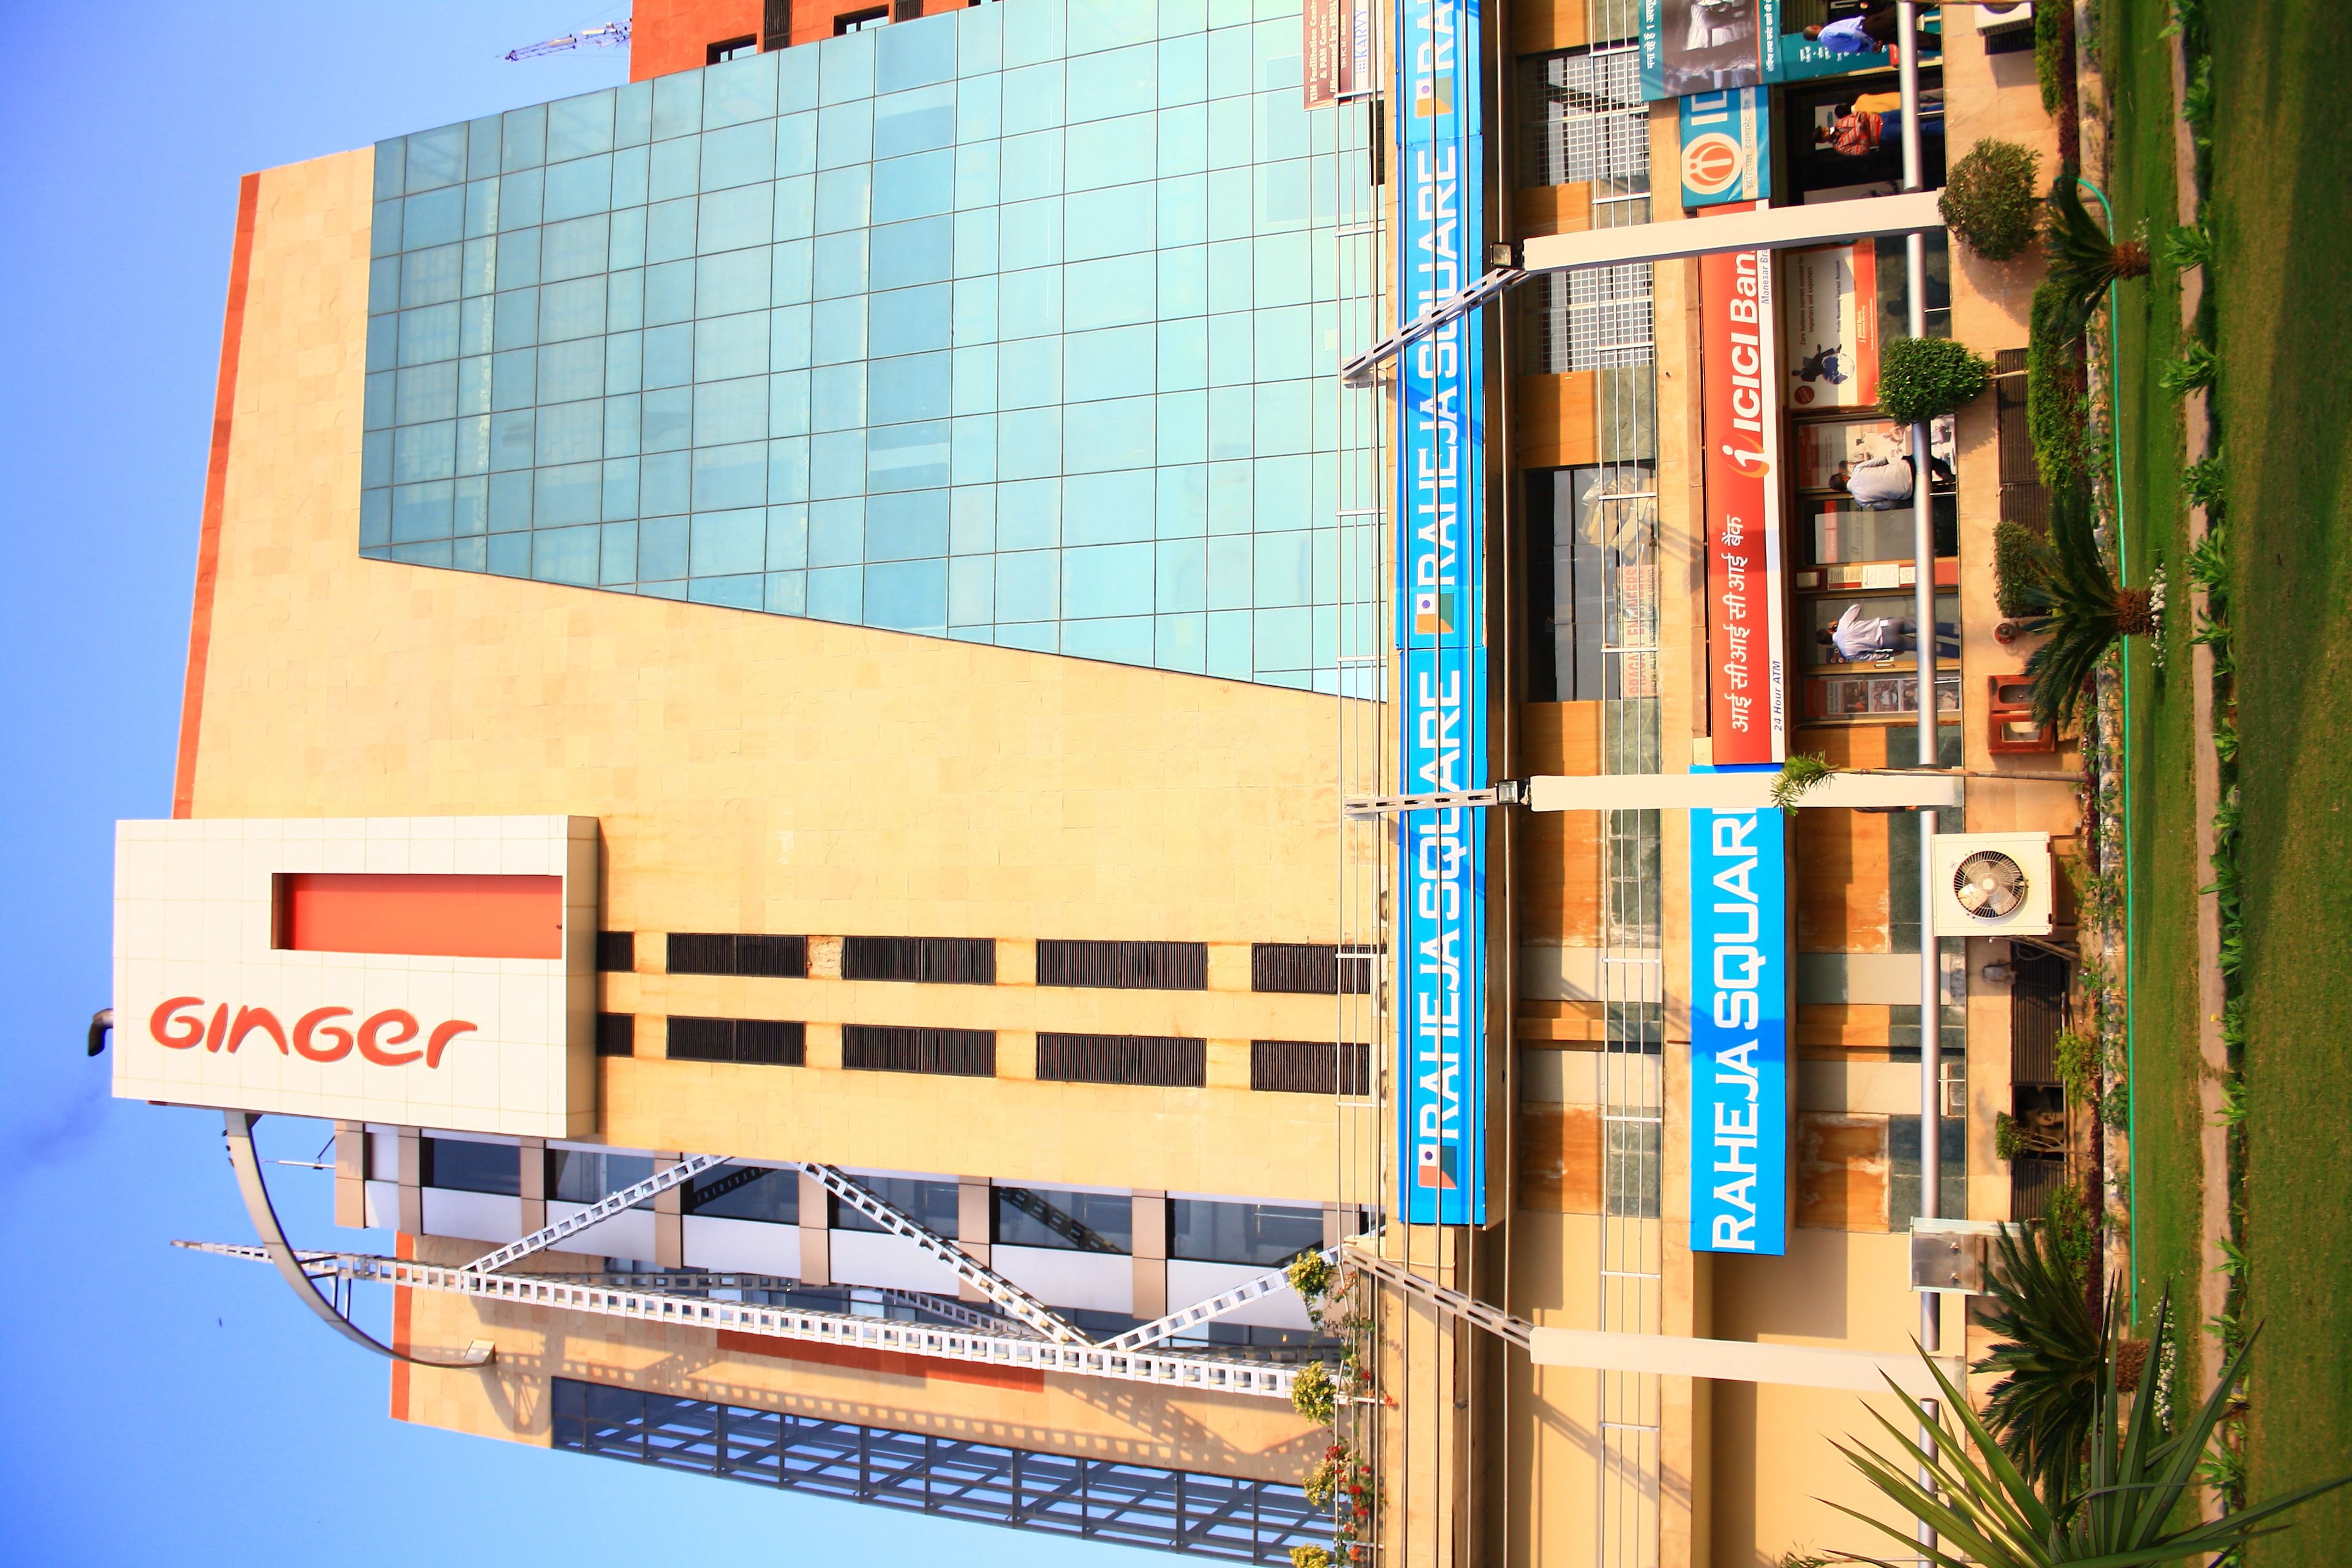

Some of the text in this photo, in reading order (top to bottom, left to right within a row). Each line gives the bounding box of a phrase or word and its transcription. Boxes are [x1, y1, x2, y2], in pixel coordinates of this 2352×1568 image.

[1308, 0, 1317, 26] Centr
[1355, 9, 1367, 59] KARVY
[1416, 0, 1454, 75] RA
[1646, 0, 1657, 23] अक्तू
[1308, 28, 1317, 83] Facilitation
[1319, 13, 1327, 79] & PAN Centre
[1643, 40, 1656, 51] रहे
[1646, 53, 1656, 69] मना
[1761, 266, 1770, 304] Manesar
[1729, 251, 1761, 432] ICICI Ban
[1417, 385, 1458, 587] RAHEJA
[1721, 514, 1744, 546] बैंक
[1627, 643, 1646, 693] PRAGAI
[1772, 660, 1782, 731] 24 Hour ATM
[1419, 669, 1467, 1139] RAHEJA SQUARE
[1711, 807, 1766, 1251] RAHEJA SQUAR
